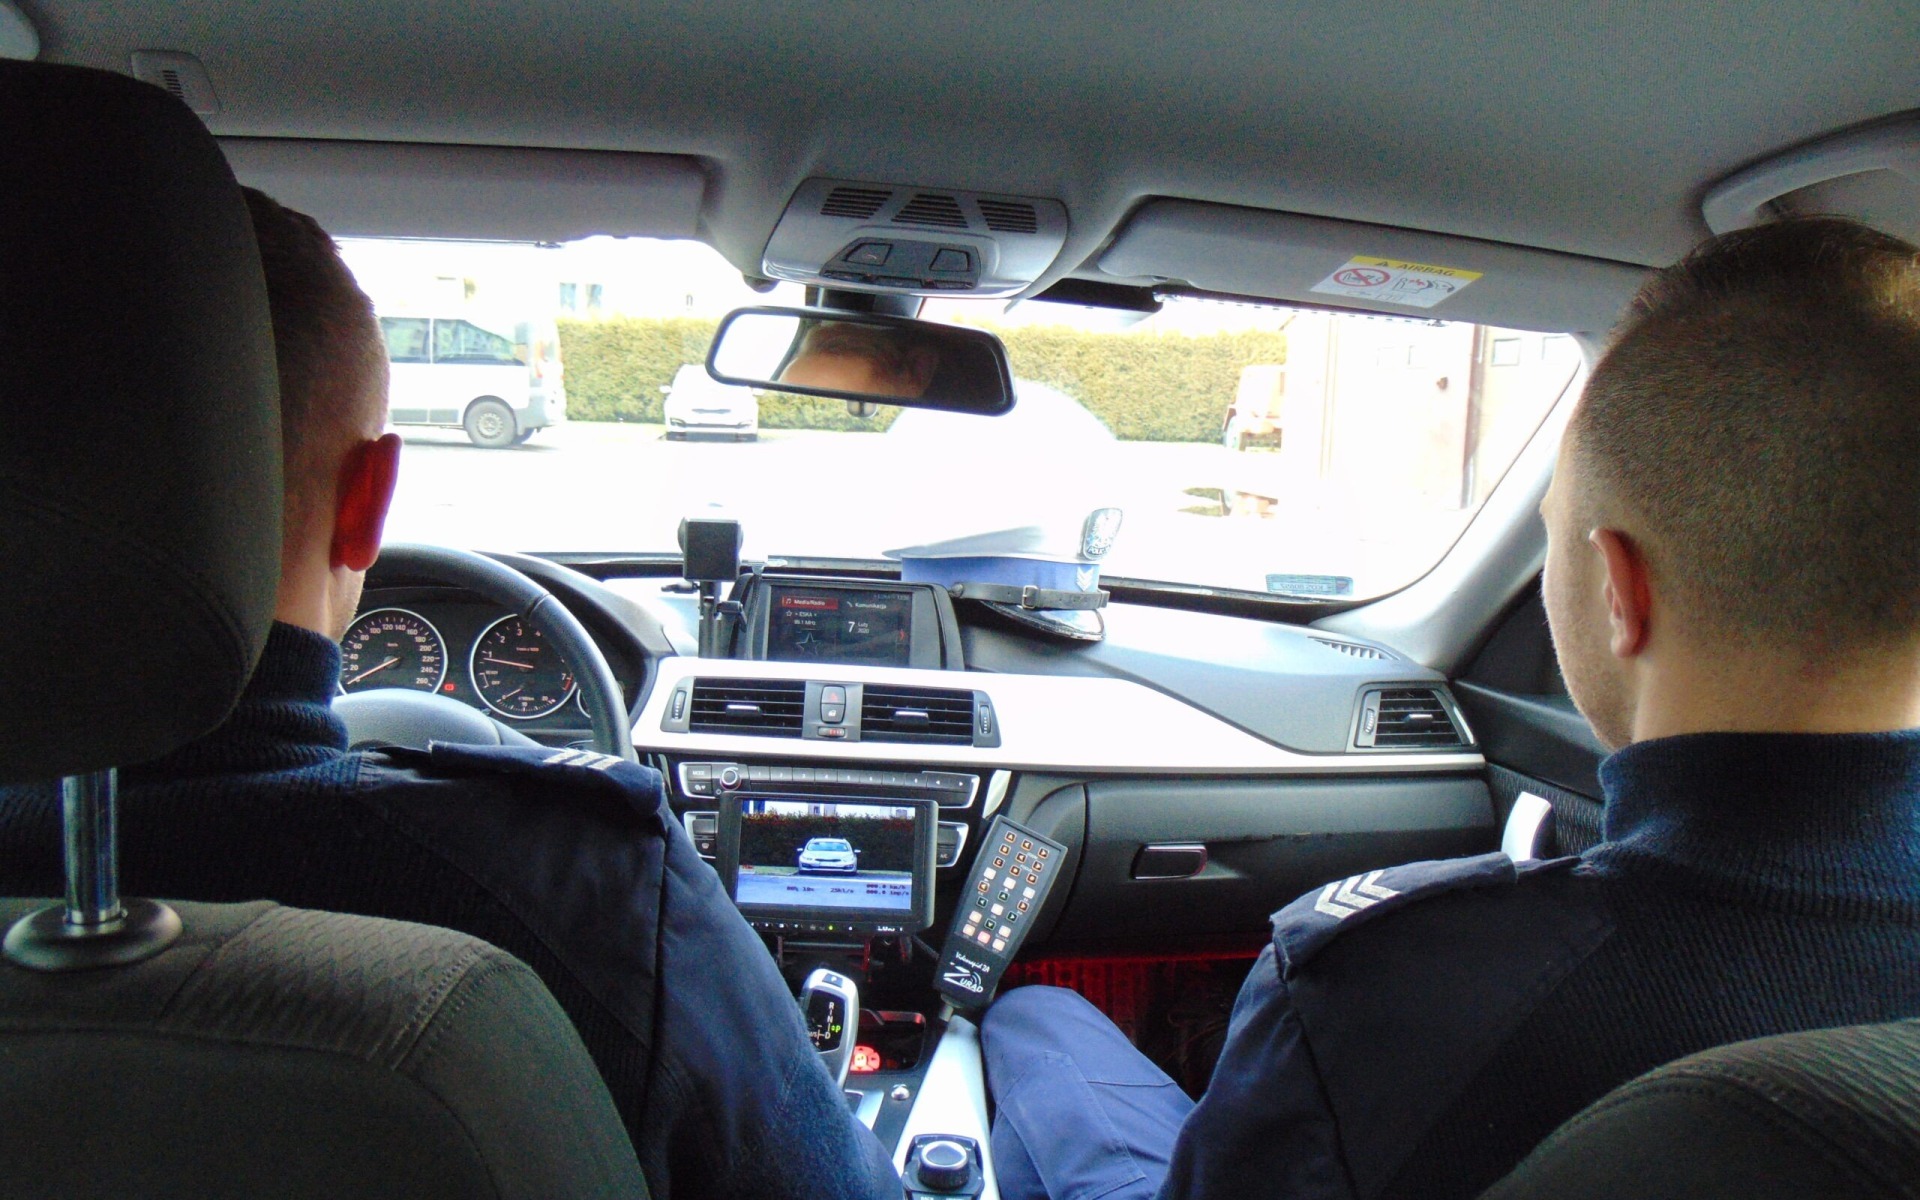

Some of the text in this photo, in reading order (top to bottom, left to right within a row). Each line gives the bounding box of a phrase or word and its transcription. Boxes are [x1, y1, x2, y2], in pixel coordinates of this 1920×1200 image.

[1396, 263, 1456, 276] AIRBAG
[517, 628, 523, 636] 3
[848, 622, 855, 633] 7
[500, 635, 506, 644] 2
[561, 673, 567, 681] 7
